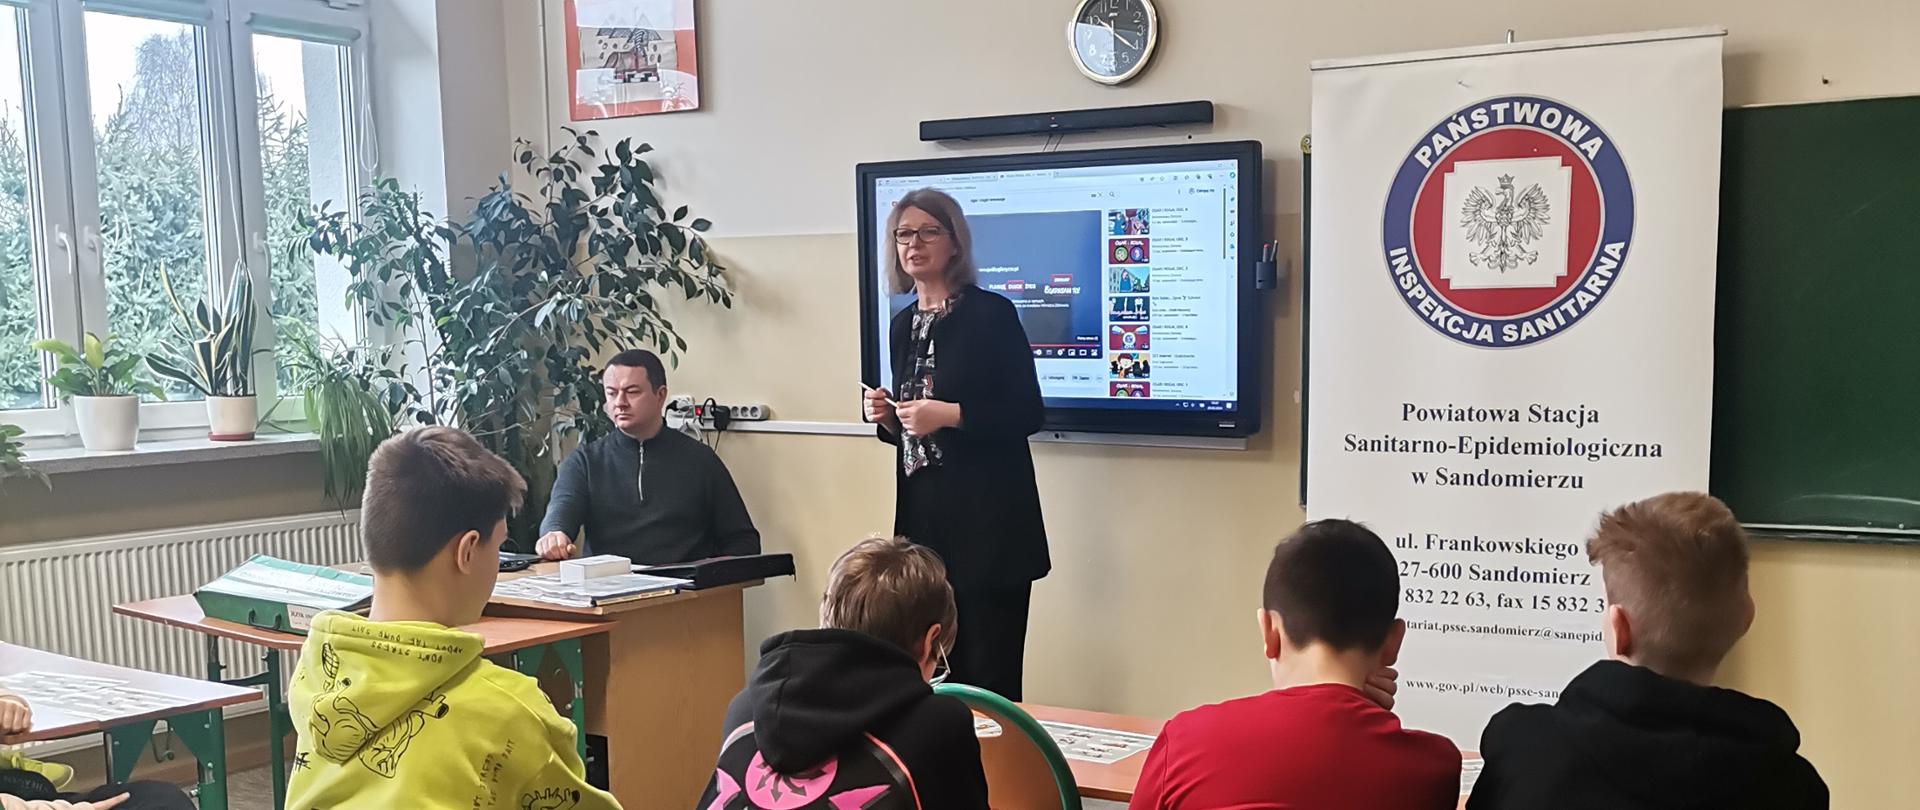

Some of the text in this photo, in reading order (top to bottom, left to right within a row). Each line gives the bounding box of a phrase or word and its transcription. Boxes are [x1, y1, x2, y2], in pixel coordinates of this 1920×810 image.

[1133, 11, 1142, 23] 2
[1136, 24, 1144, 37] 3
[1121, 51, 1130, 64] 5
[1414, 101, 1603, 169] PAŃSTWOWA
[1389, 241, 1626, 344] INSPEKCJA SANITARNA
[1401, 402, 1600, 429] Powiatowa Stacja
[1344, 433, 1663, 462] Sanitarno-Epidemiologiczna
[1411, 467, 1584, 490] w Sandomierzu
[1396, 533, 1579, 560] ul. Frankowskiego
[1399, 560, 1592, 587] 27-600 Sandomierz
[1405, 588, 1605, 613] 832 22 63, fax 15 832 3
[1406, 619, 1603, 643] tariat.psse.sandomierz@sanepid
[1406, 680, 1561, 699] www.gov.pl/web/psse-san
